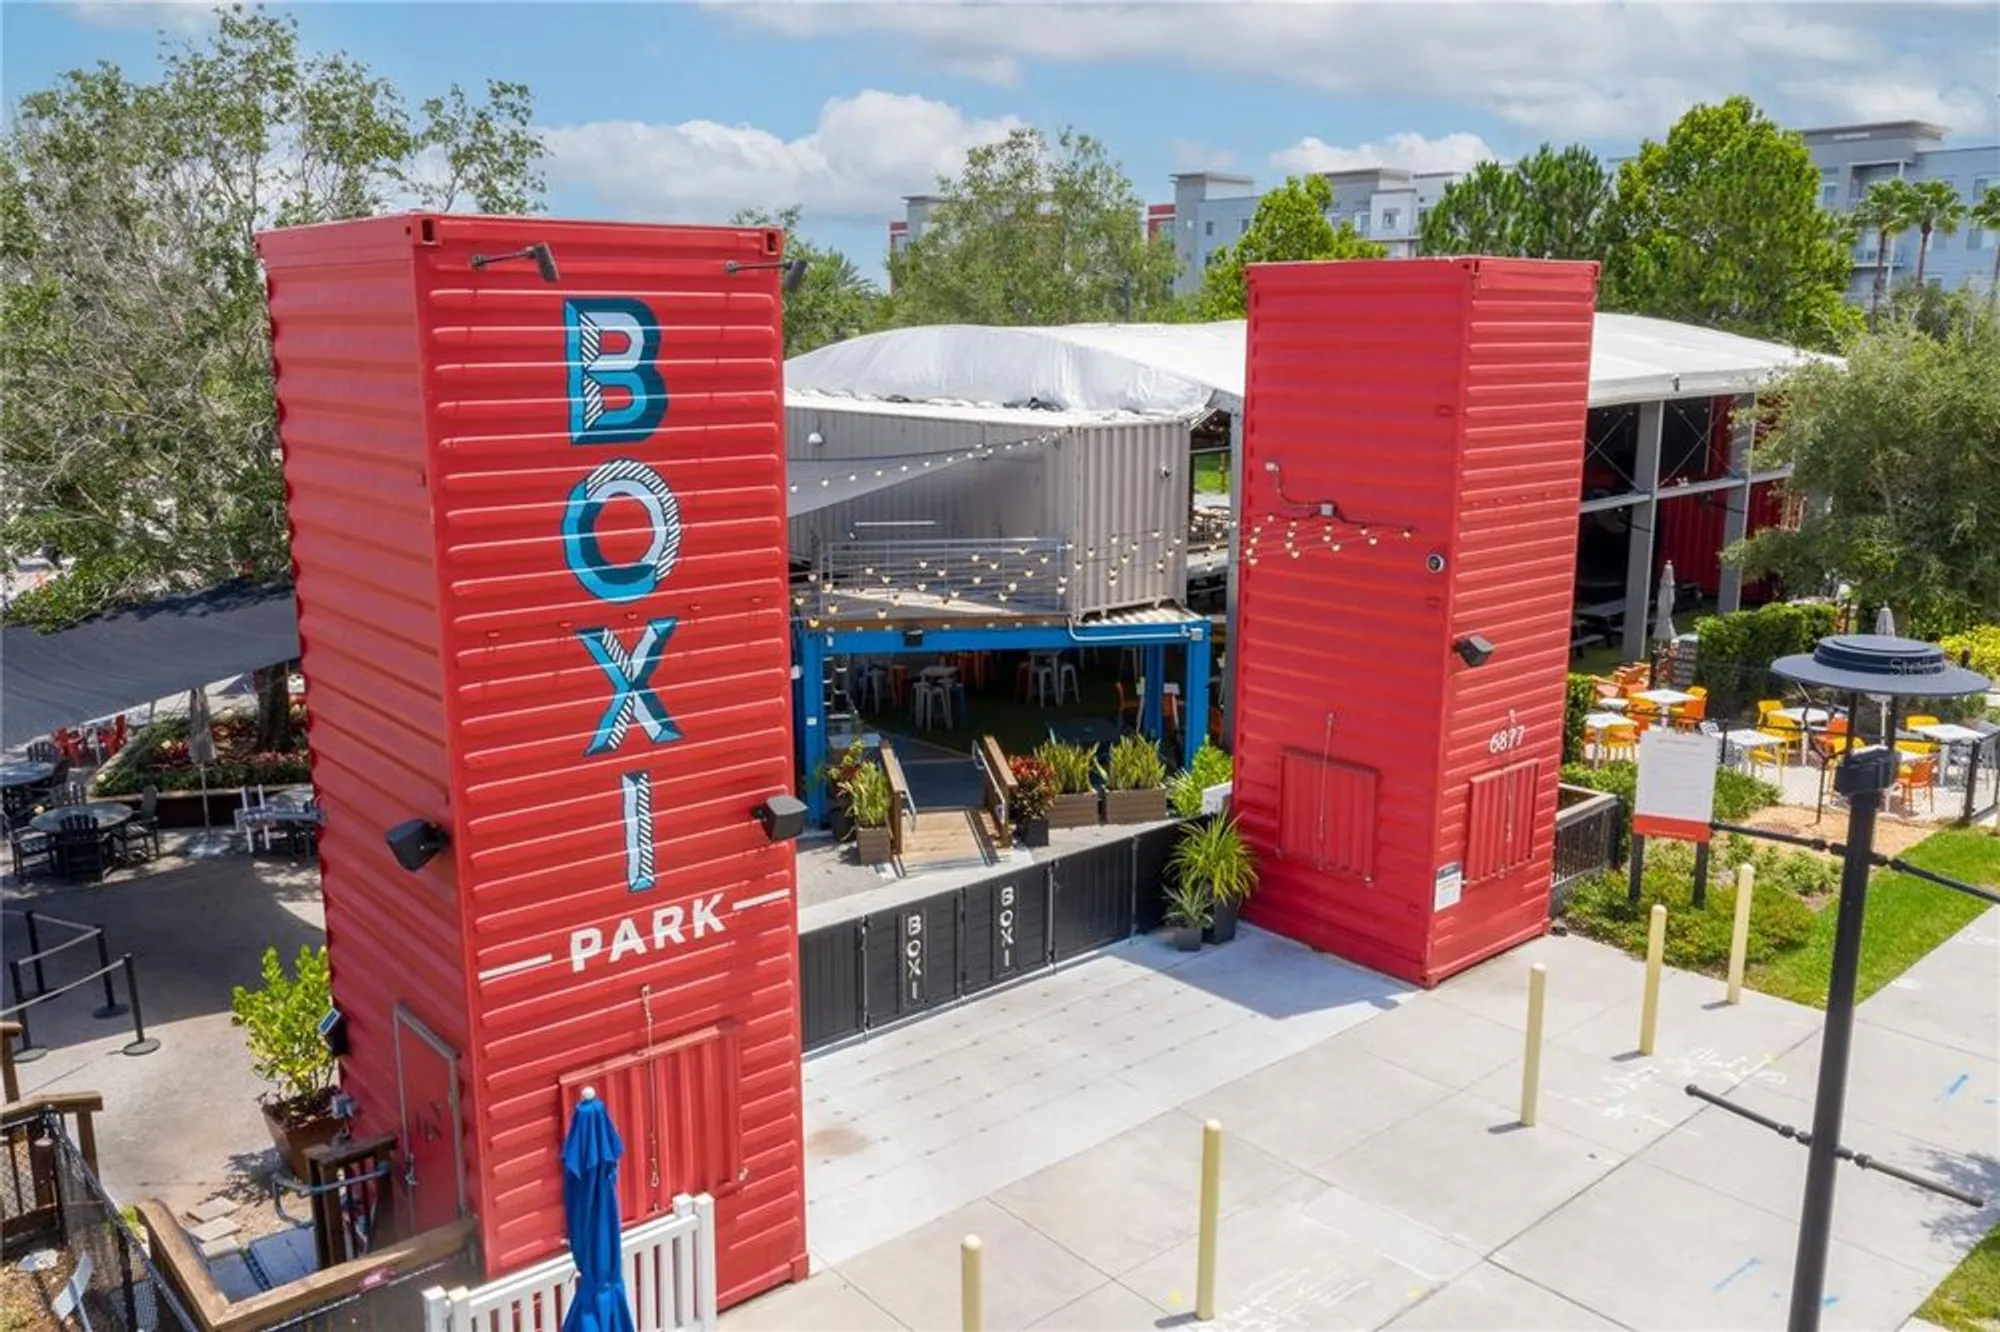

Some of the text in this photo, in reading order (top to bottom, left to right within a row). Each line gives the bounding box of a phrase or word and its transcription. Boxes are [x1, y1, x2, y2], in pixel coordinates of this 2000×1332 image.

[563, 297, 683, 893] BOXI
[1490, 724, 1526, 753] 6877
[569, 893, 727, 973] PARK
[907, 914, 922, 1000] BOXI
[1000, 886, 1015, 967] BOXI
